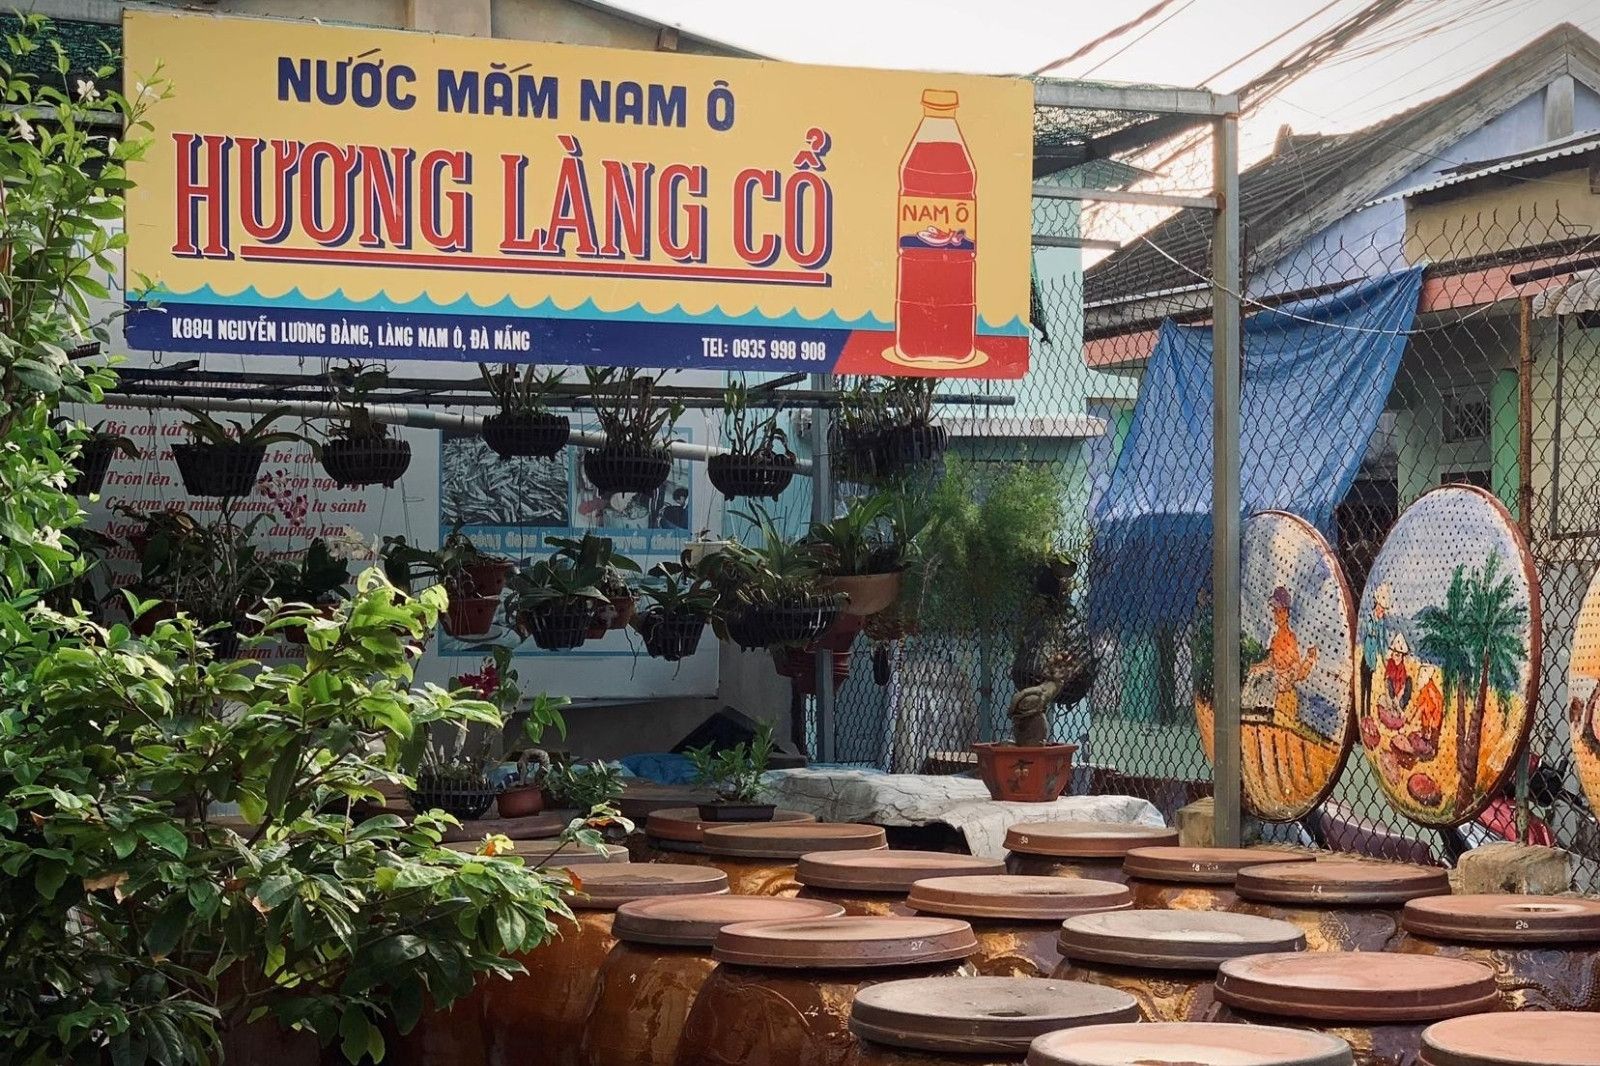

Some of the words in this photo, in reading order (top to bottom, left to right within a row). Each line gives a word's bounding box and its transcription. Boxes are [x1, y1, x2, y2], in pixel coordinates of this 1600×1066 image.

[277, 48, 416, 110] NƯỚC
[437, 62, 558, 119] MẮM
[580, 79, 687, 128] NAM
[707, 80, 735, 131] Ô
[171, 132, 473, 260] HƯƠNG
[500, 134, 707, 263] LÀNG
[733, 127, 833, 269] CỔ
[902, 204, 949, 224] NAM
[956, 202, 969, 223] Ô
[172, 317, 213, 339] K884
[218, 315, 276, 342] NGUYỄN
[378, 322, 414, 347] LÀNG
[418, 327, 448, 348] NAM
[453, 325, 466, 351] Ô,
[470, 325, 490, 350] ĐÀ
[702, 337, 729, 357] TEL:
[732, 339, 766, 359] 0935
[770, 340, 797, 360] 998
[801, 341, 826, 361] 908
